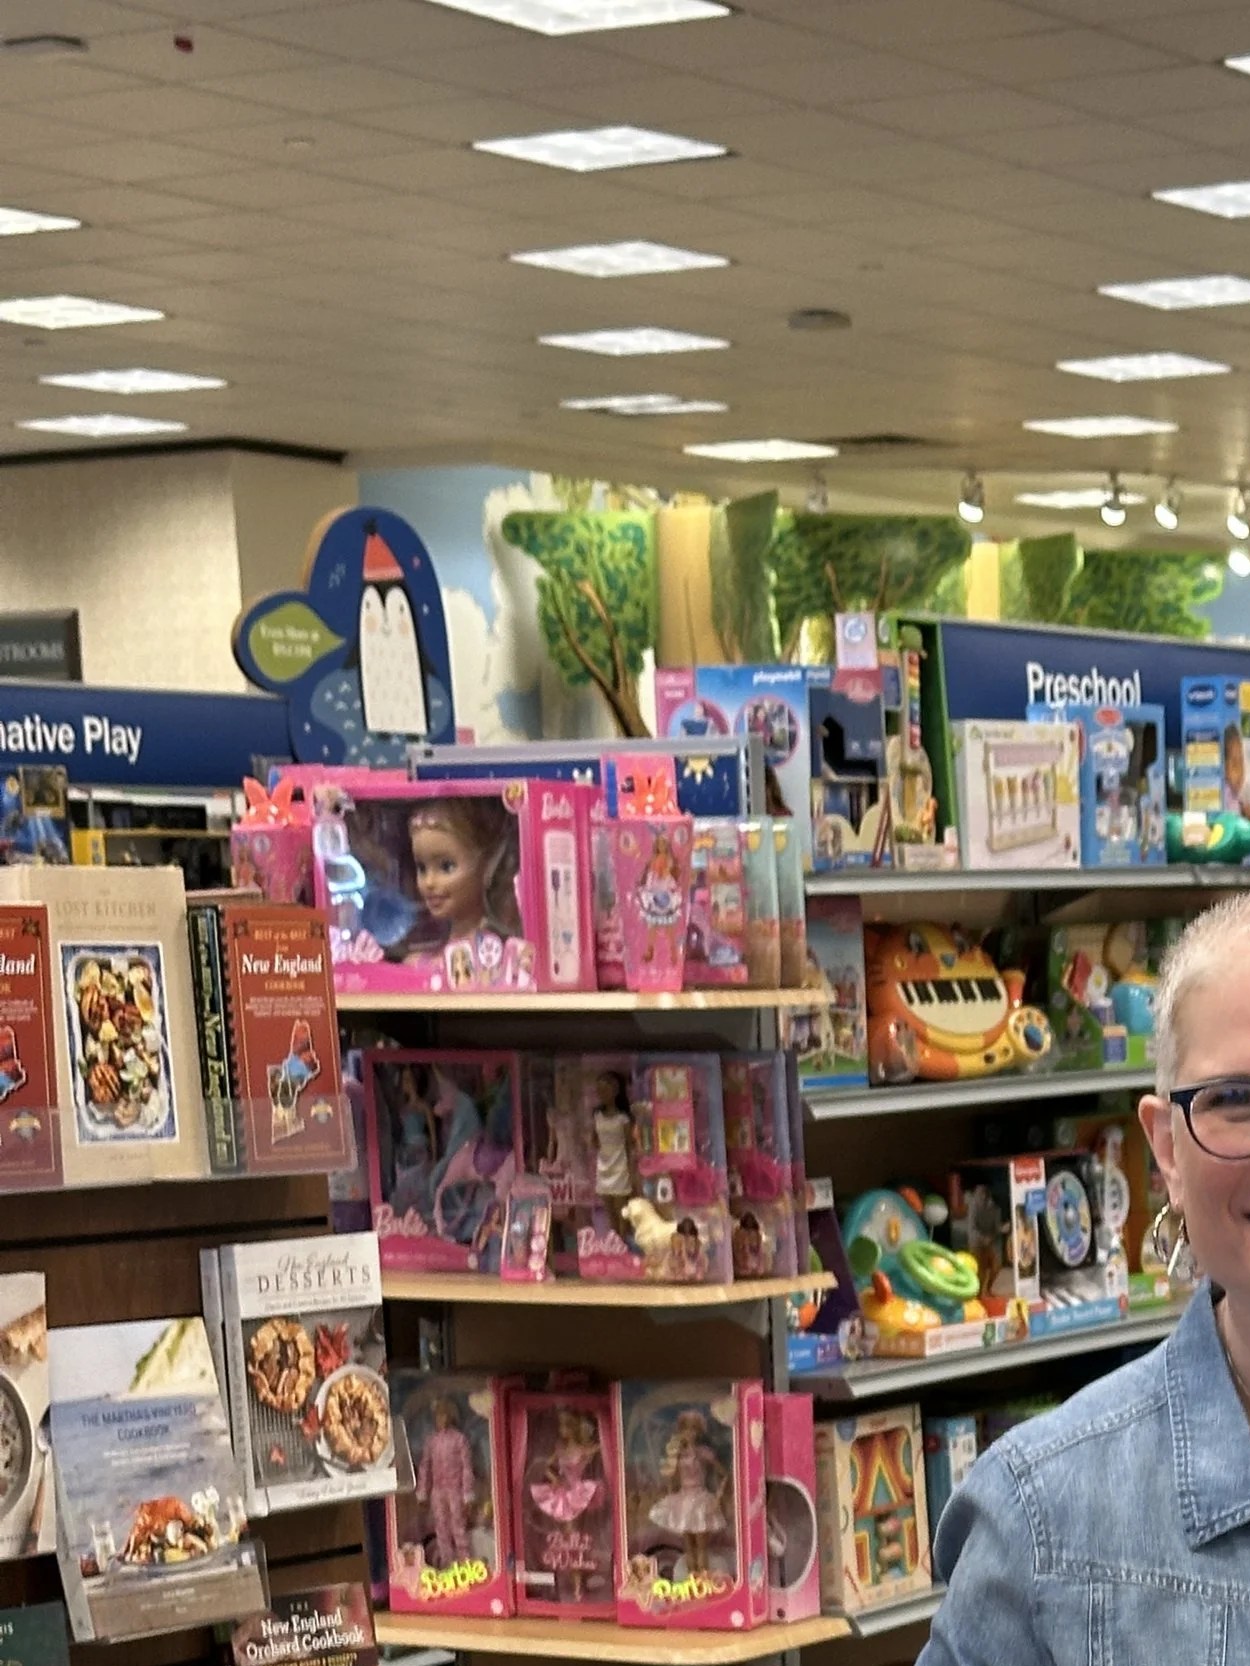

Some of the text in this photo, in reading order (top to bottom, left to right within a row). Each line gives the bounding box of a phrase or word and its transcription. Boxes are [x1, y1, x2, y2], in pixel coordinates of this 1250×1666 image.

[1026, 661, 1142, 708] Preschool
[83, 714, 142, 766] Play
[242, 953, 322, 977] New England
[257, 1264, 372, 1294] DESSERTS
[421, 1558, 488, 1599] Barbie
[260, 1607, 343, 1638] New England
[246, 1625, 365, 1661] Orchard Cookbook
